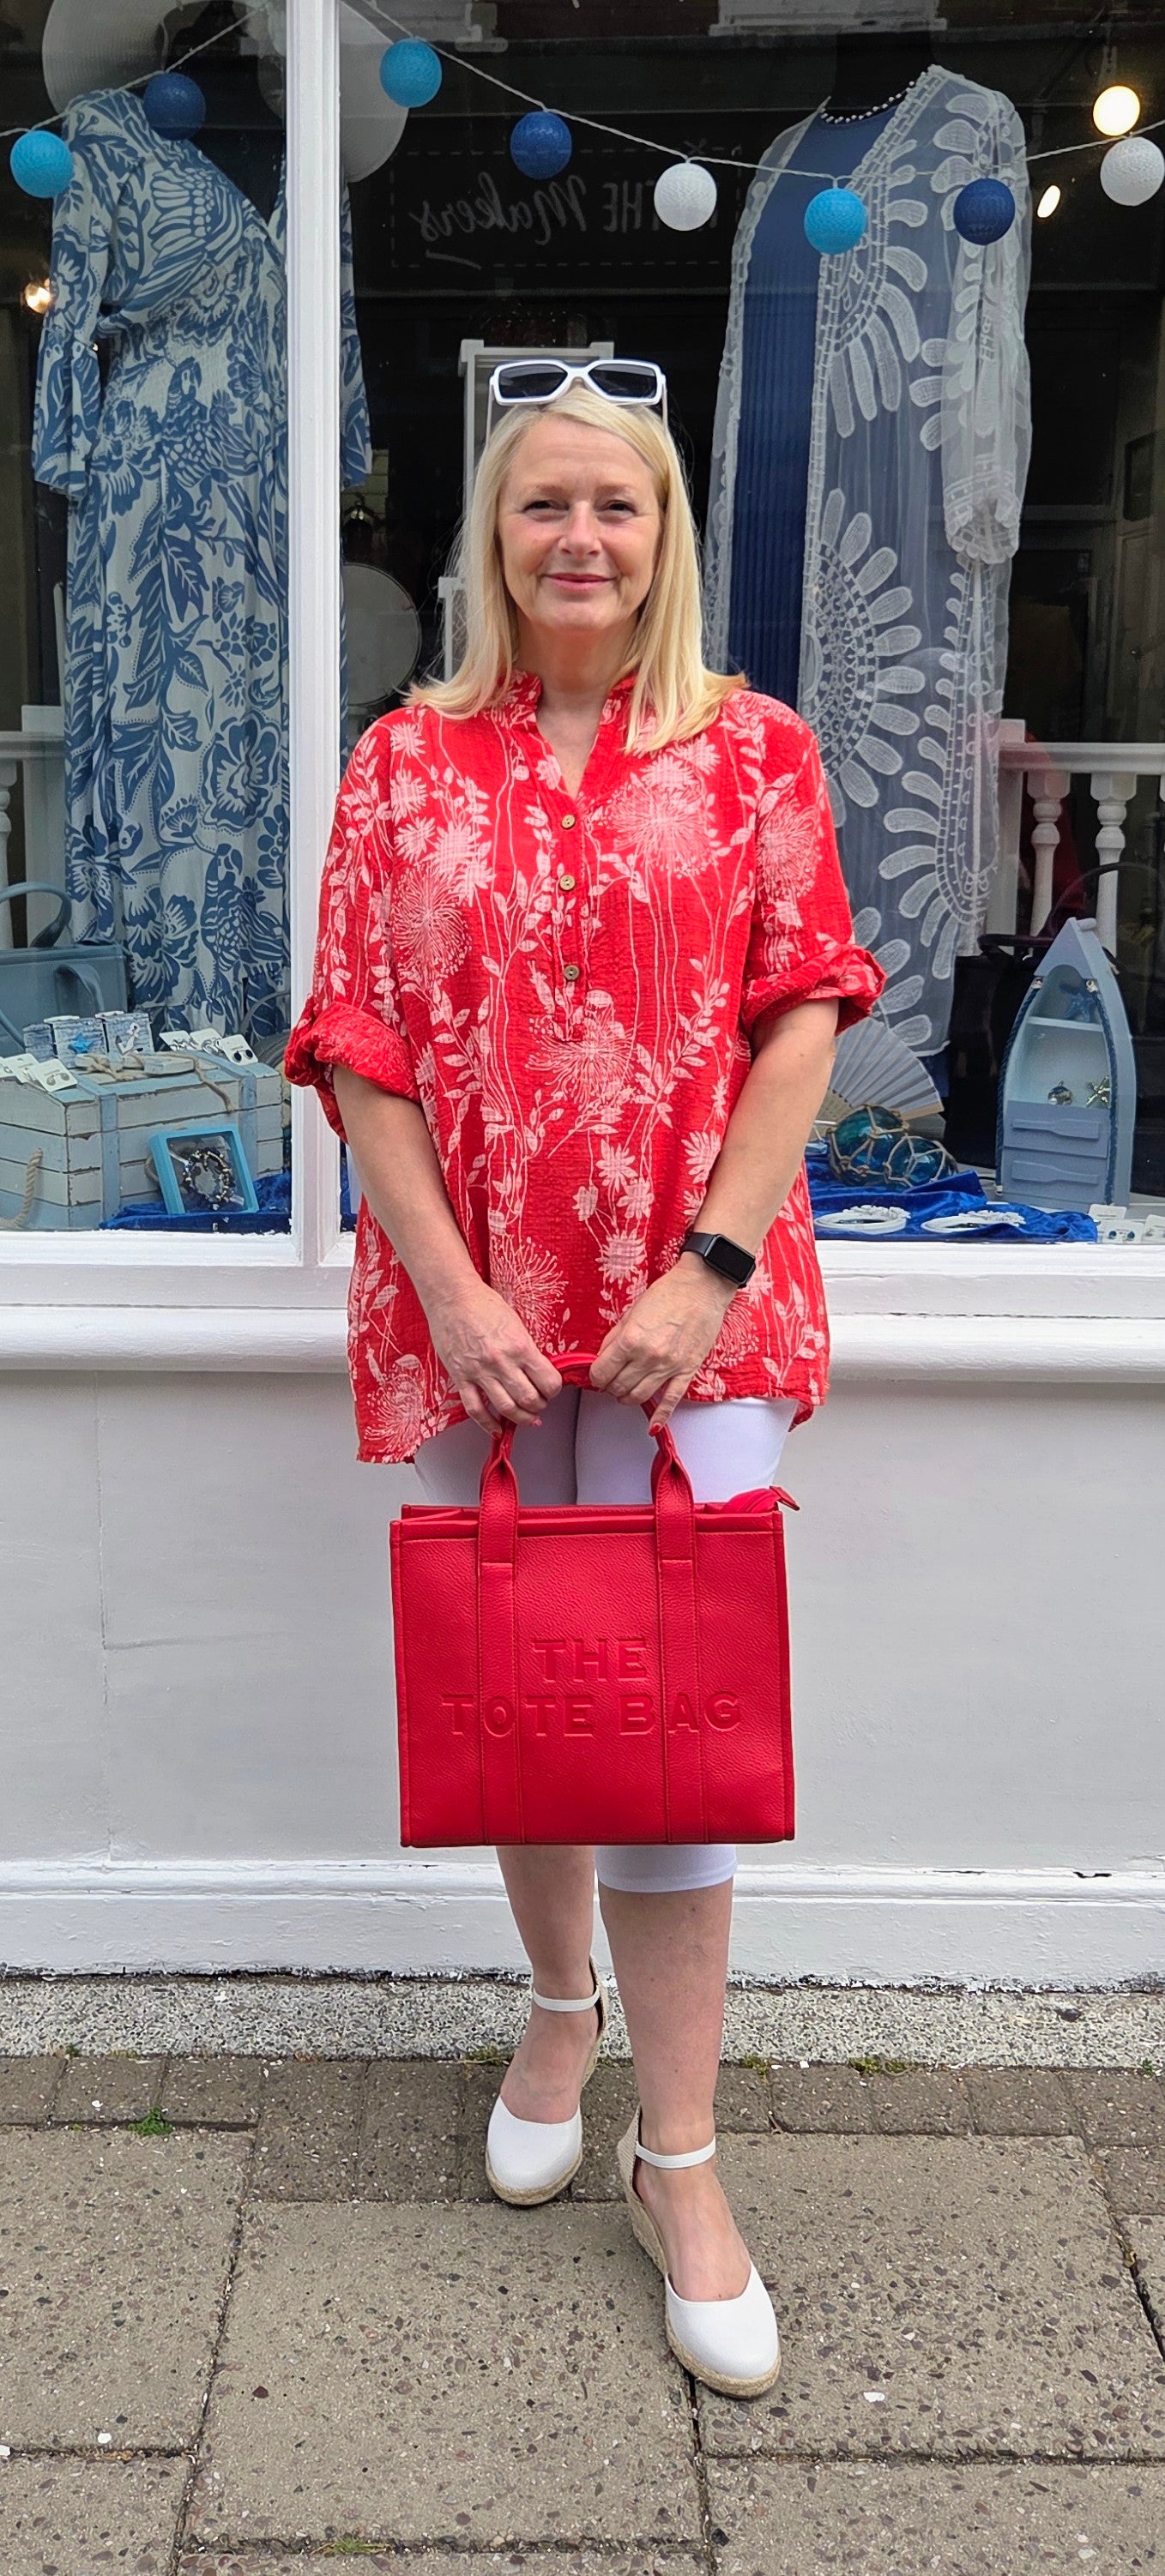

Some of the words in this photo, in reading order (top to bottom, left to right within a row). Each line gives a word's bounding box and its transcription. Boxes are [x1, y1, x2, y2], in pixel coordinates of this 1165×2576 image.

[532, 1637, 649, 1683] THE
[441, 1693, 595, 1737] TOTE
[618, 1691, 743, 1735] BAG
